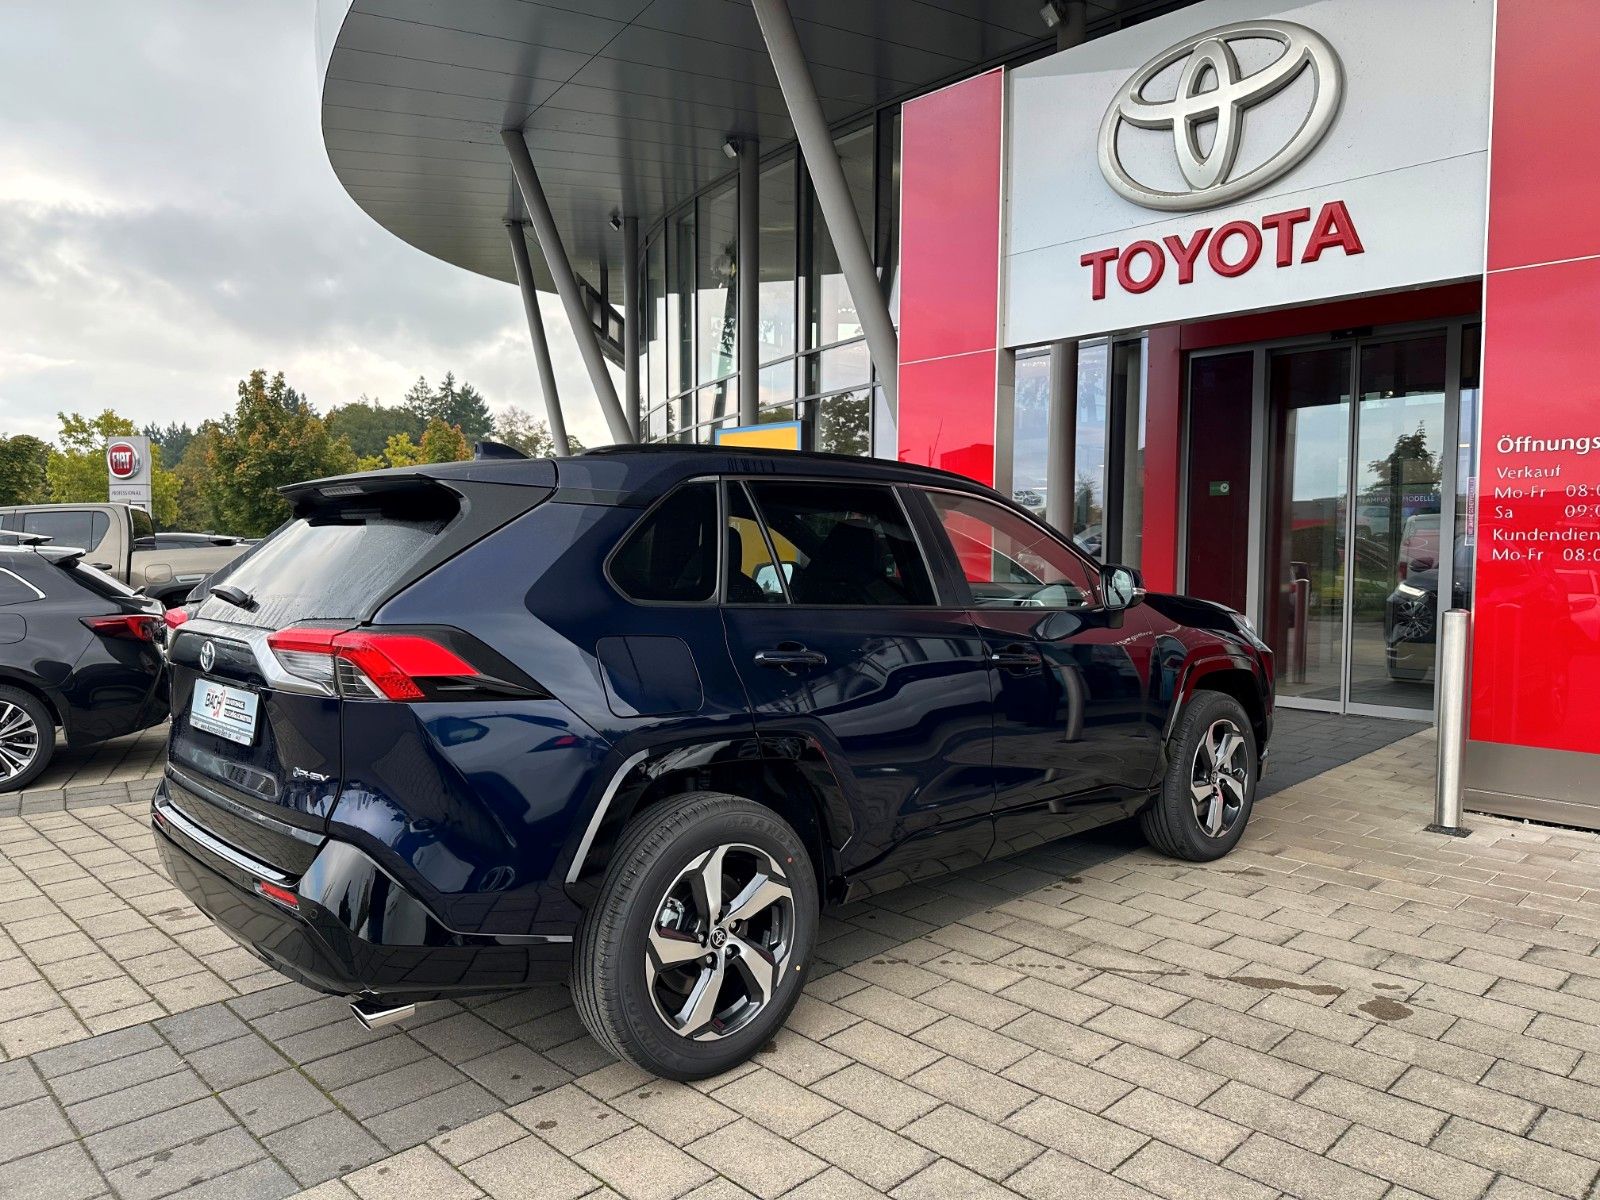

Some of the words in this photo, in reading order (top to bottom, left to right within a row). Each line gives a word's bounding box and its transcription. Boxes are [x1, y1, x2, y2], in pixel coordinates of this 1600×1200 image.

[1080, 200, 1365, 301] TOYOTA
[1496, 435, 1600, 454] Öffnungs
[111, 451, 132, 469] FIAT
[1496, 465, 1561, 479] Verkauf
[1402, 495, 1435, 503] MODELLE
[1495, 486, 1546, 499] Mo-Fr
[1494, 505, 1513, 519] Sa
[1492, 548, 1544, 561] Mo-Fr
